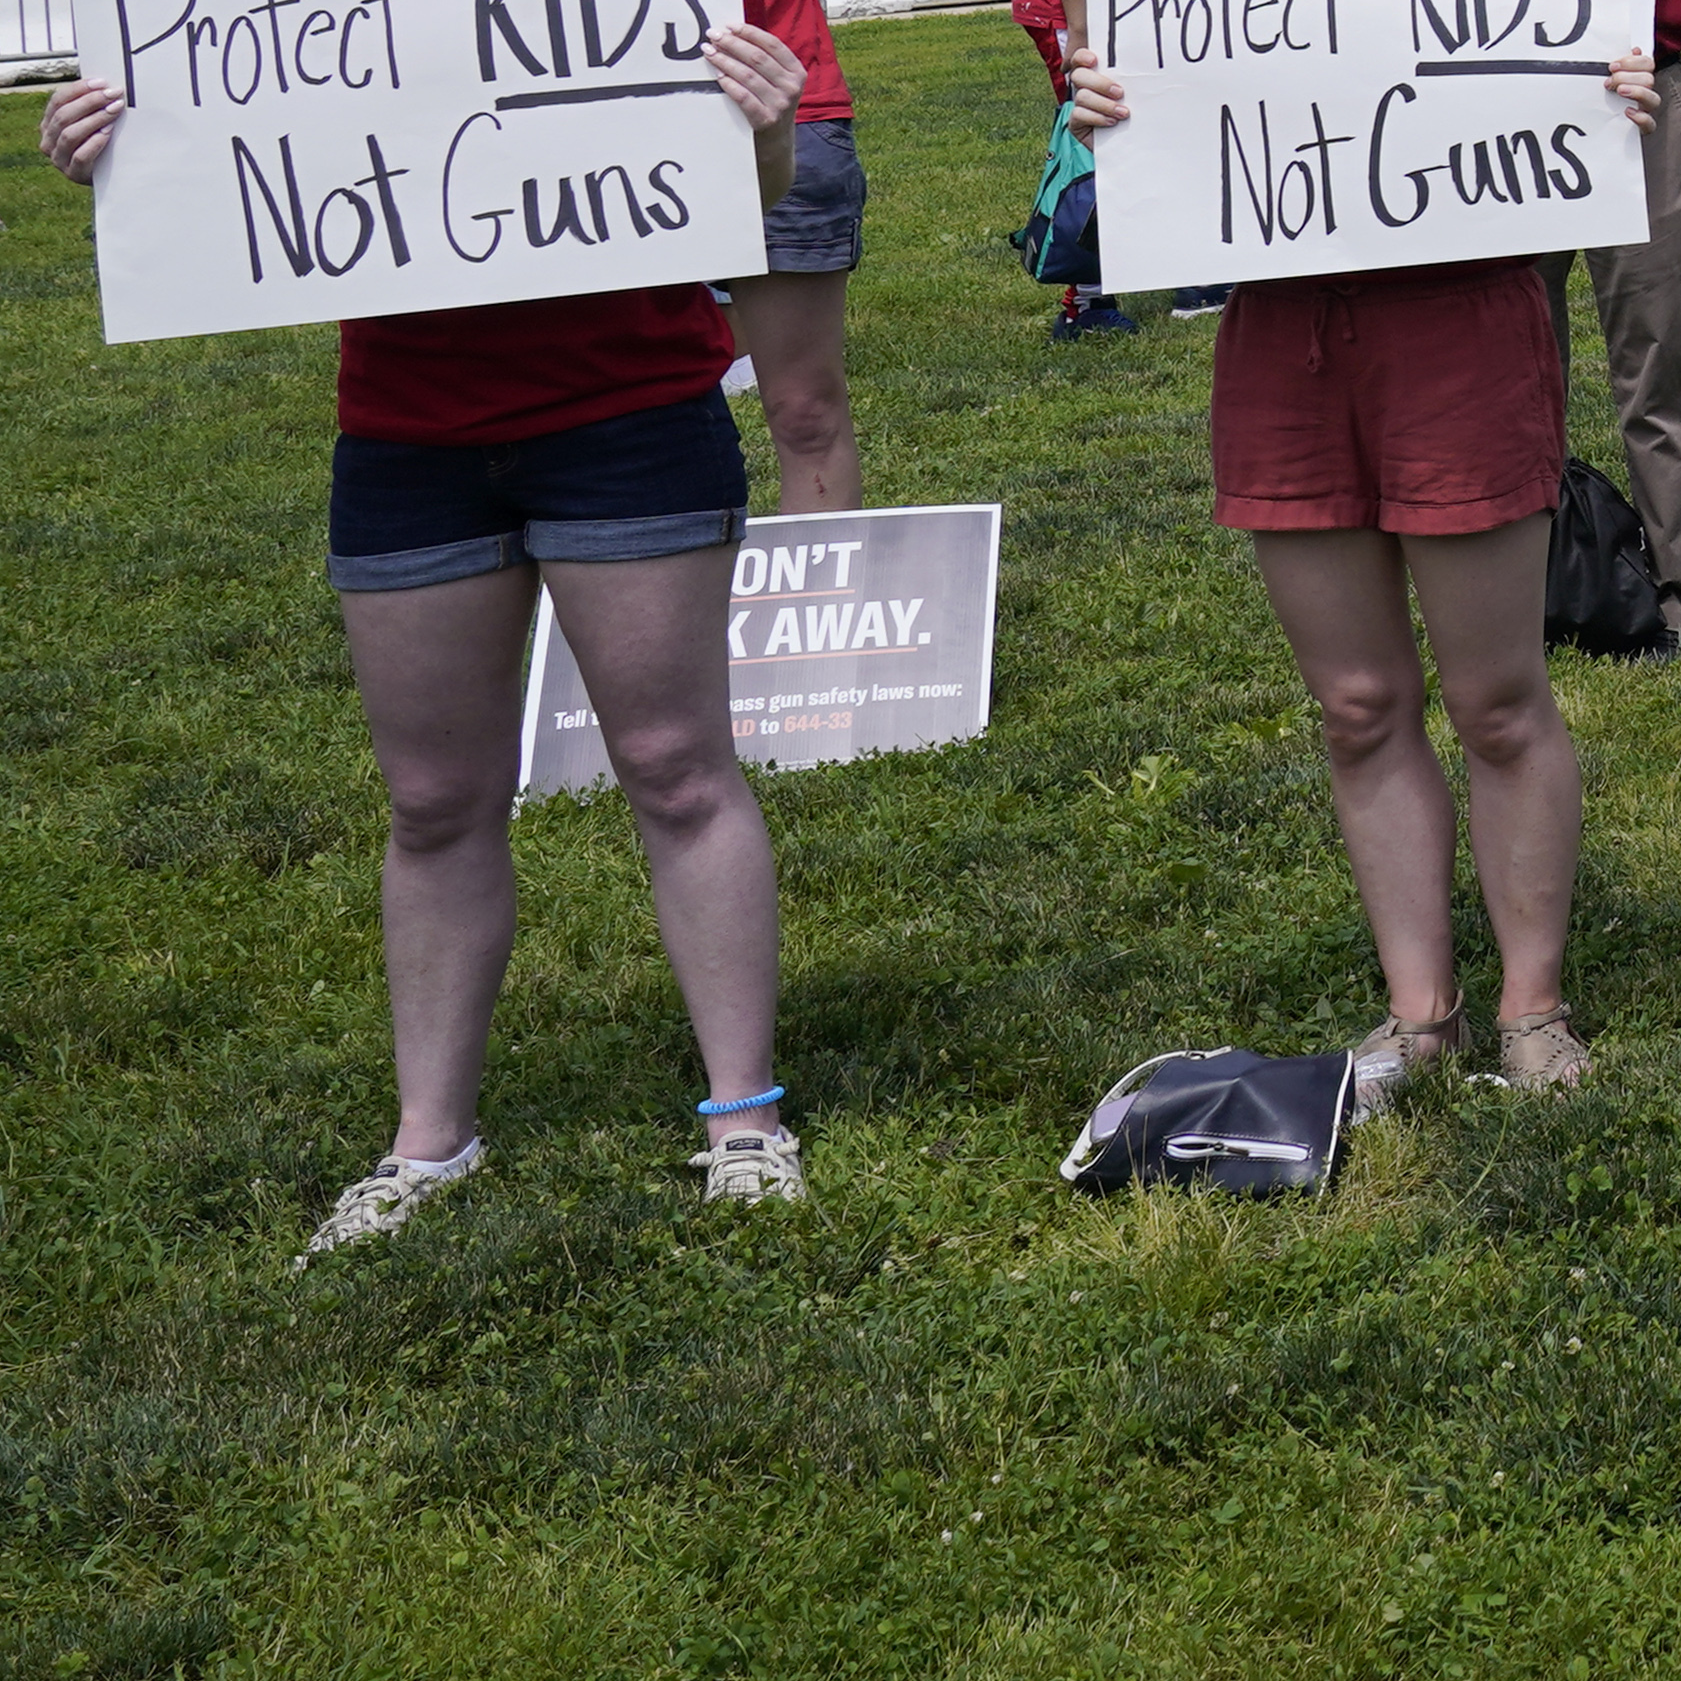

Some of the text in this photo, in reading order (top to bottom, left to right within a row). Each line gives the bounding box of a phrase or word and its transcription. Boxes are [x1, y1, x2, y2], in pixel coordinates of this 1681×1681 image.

[1221, 83, 1592, 246] Not Guns
[232, 112, 689, 284] Not Guns
[731, 541, 862, 596] ON'T
[764, 598, 932, 656] AWAY.
[555, 709, 587, 729] Tell
[769, 693, 803, 714] gun
[808, 686, 867, 707] safety
[872, 684, 914, 702] laws
[919, 682, 963, 699] now:
[760, 718, 780, 735] to
[784, 711, 852, 733] 644-33
